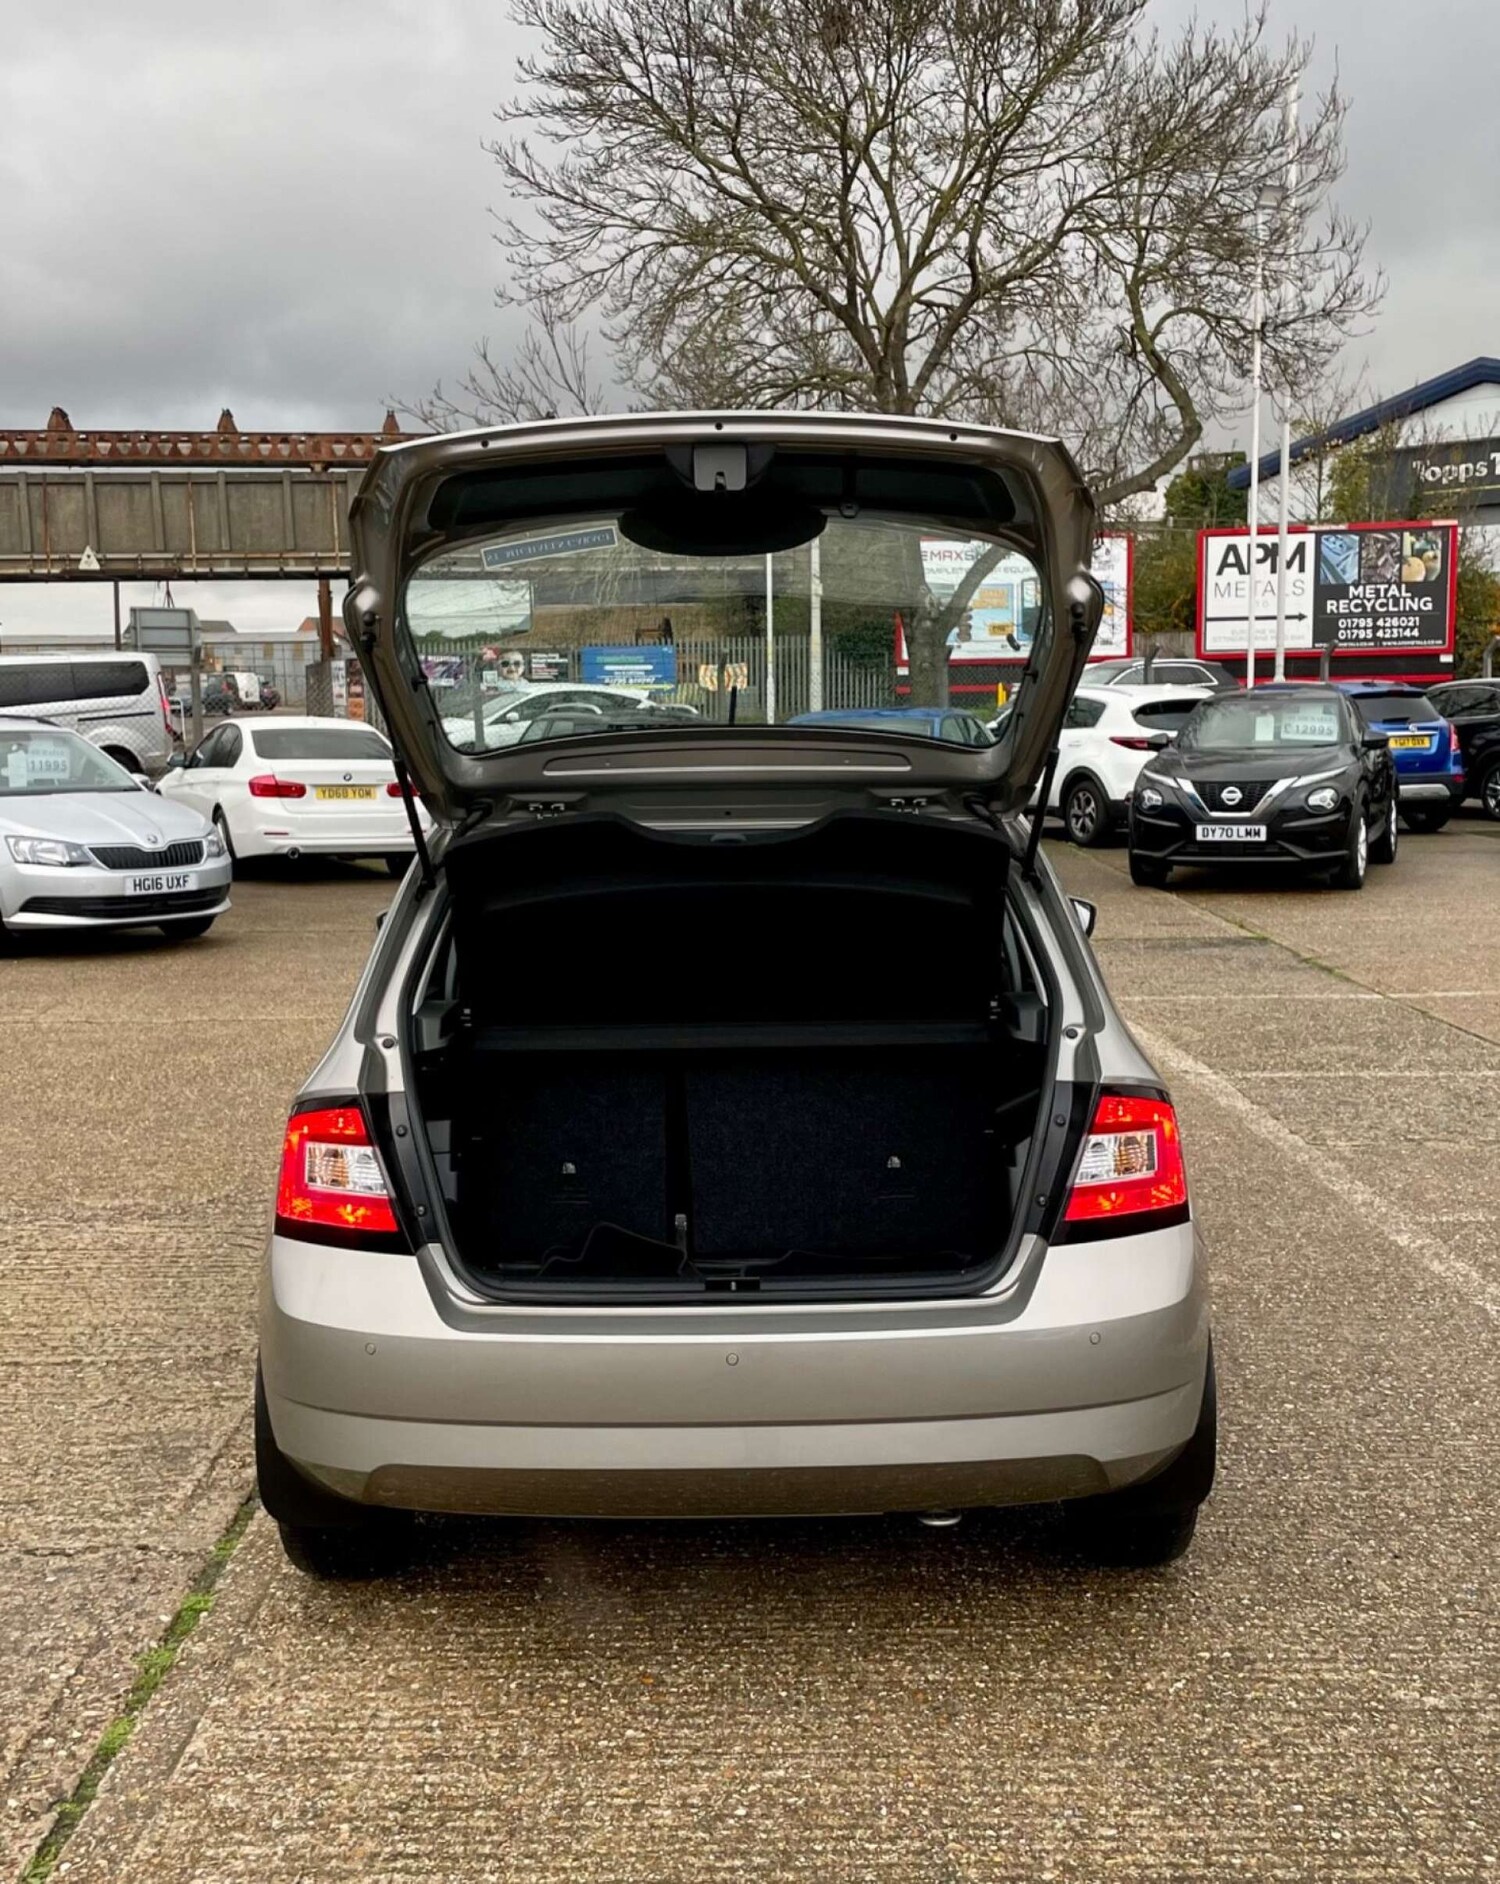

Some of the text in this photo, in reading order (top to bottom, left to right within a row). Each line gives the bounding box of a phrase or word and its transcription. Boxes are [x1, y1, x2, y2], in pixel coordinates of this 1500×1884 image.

[1412, 459, 1488, 484] Topps
[1216, 541, 1306, 576] APM
[1214, 579, 1305, 599] METAS
[1349, 584, 1412, 599] METAL
[1326, 597, 1433, 613] RECYCLING
[1338, 616, 1419, 629] 01795 426021
[1338, 627, 1419, 639] 01795 423144
[1201, 826, 1261, 838] DY70 LMM
[133, 874, 190, 892] HG16 UXF
